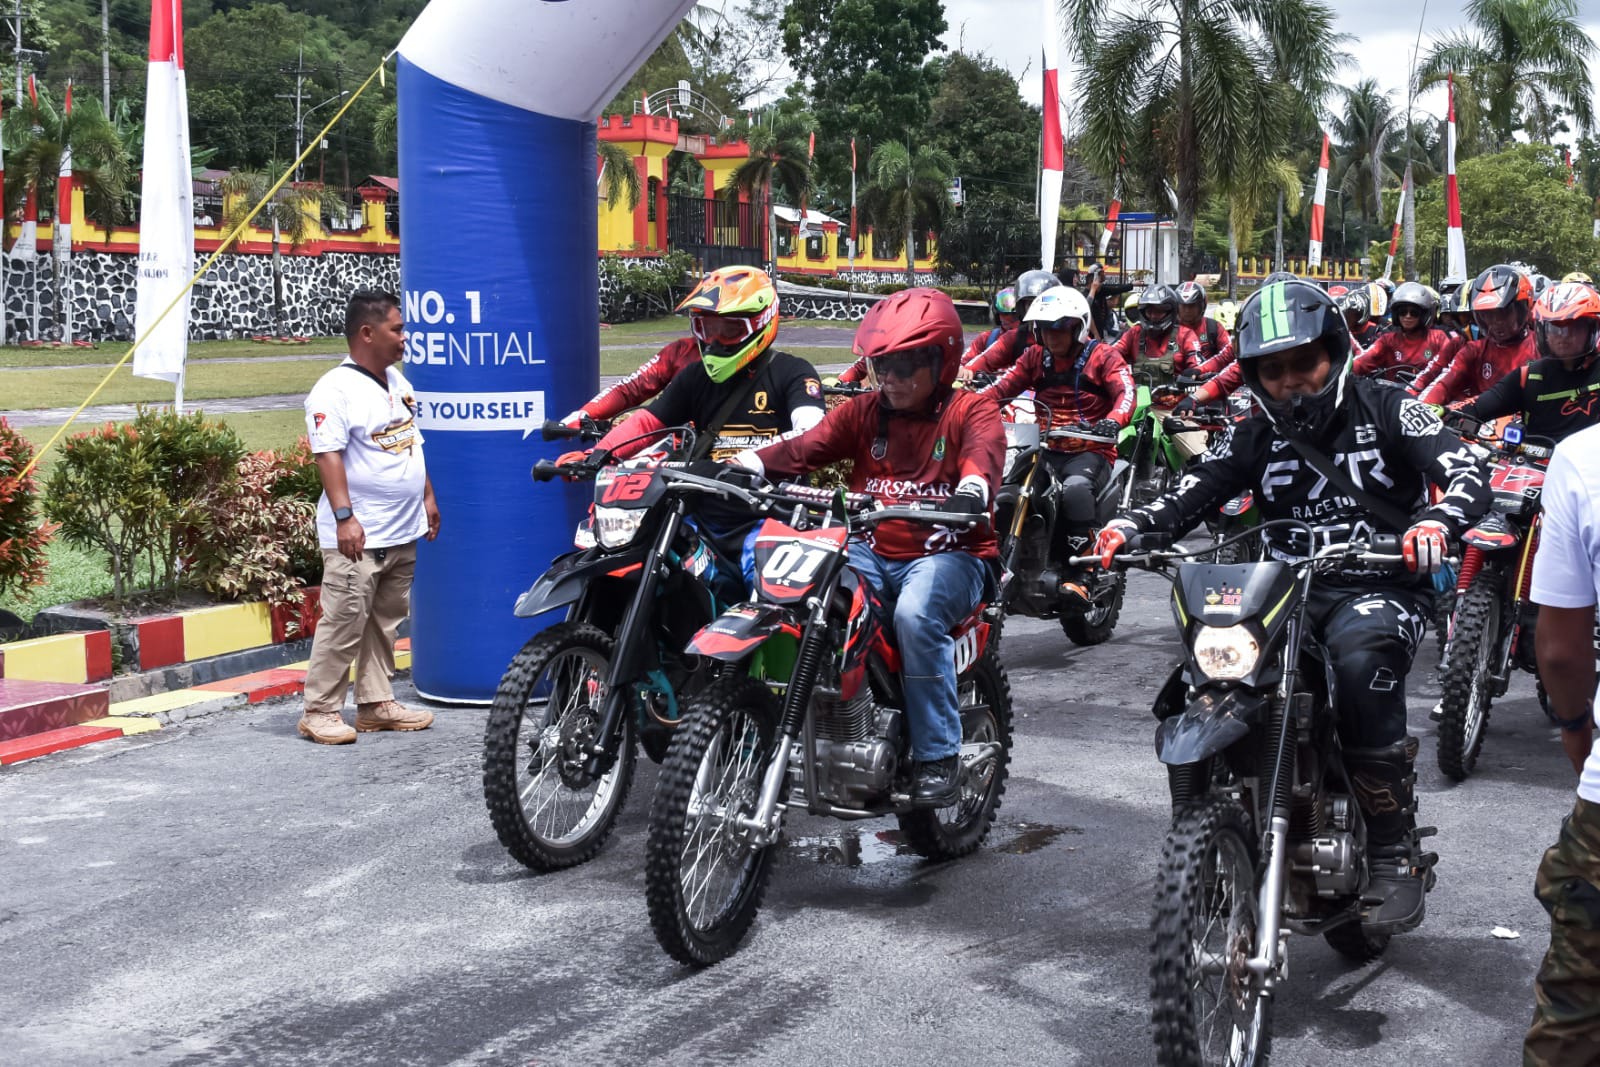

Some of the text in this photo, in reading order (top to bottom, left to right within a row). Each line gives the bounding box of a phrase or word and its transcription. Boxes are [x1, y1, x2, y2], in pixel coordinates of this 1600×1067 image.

[405, 290, 481, 324] NO. 1
[402, 331, 546, 366] SSENTIAL
[429, 401, 534, 419] YOURSELF
[602, 473, 653, 504] 02
[1292, 499, 1334, 518] RACE
[762, 543, 828, 583] 01
[956, 626, 978, 675] 01
